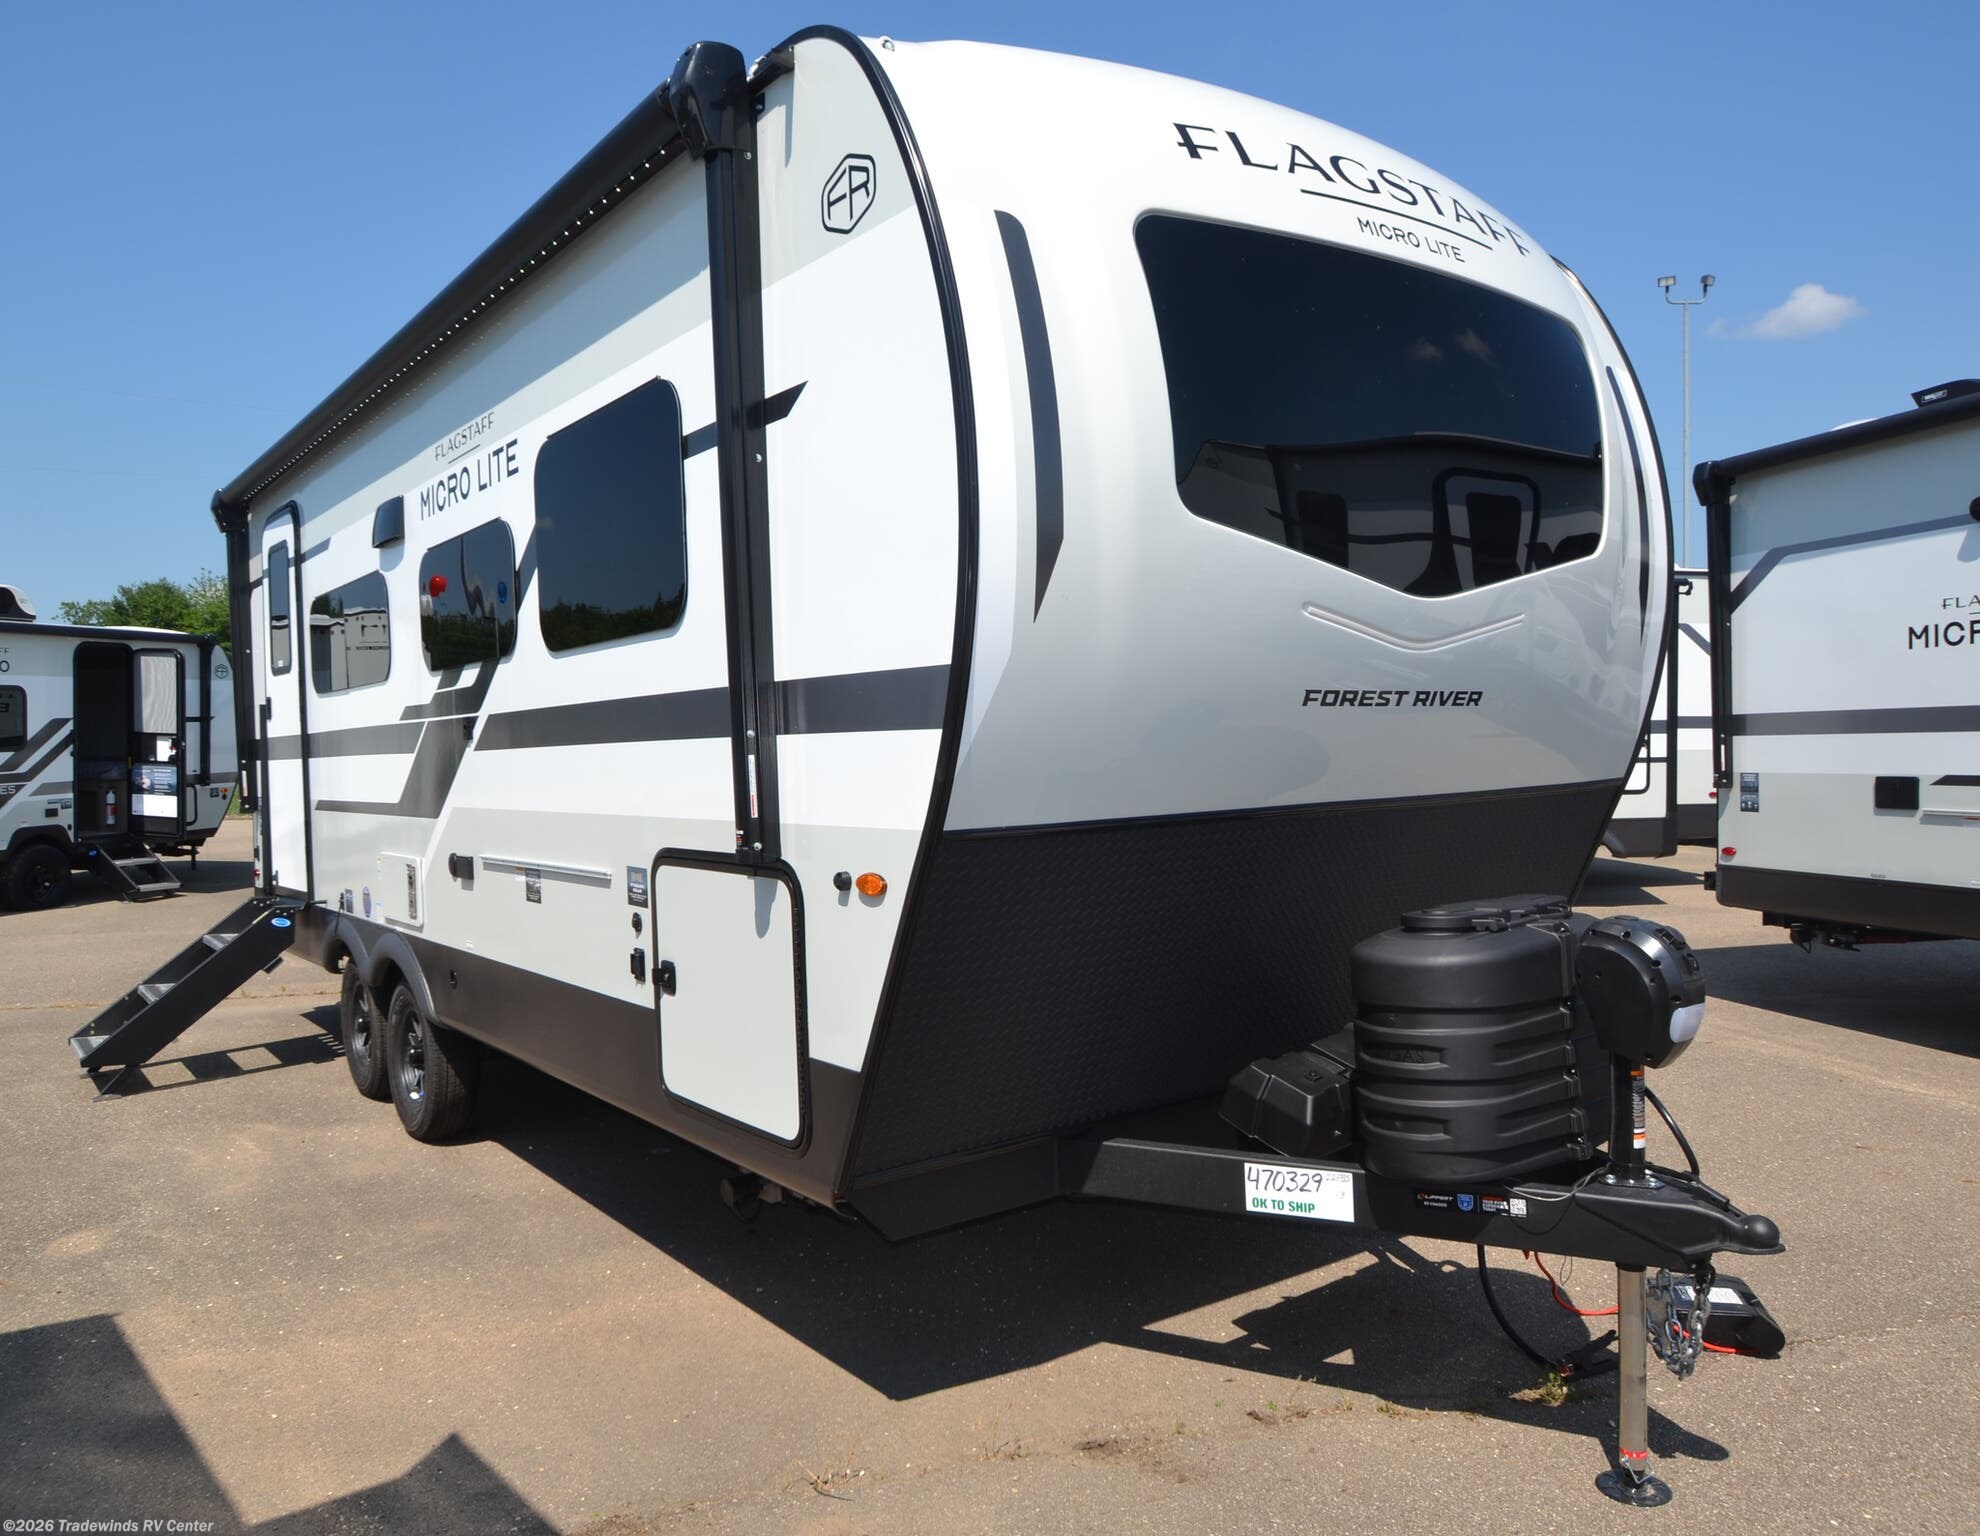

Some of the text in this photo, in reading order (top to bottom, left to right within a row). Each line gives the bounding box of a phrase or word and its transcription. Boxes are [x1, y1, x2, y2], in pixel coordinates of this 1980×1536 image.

[1172, 122, 1530, 256] FLAGSTAFF
[1356, 216, 1465, 263] MICRO LITE
[435, 411, 495, 461] FLAGSTAFF
[420, 438, 519, 520] MICRO LITE
[1302, 689, 1483, 707] FOREST RIVER
[1247, 1166, 1323, 1192] 470329
[1252, 1197, 1316, 1213] OK TO SHIP
